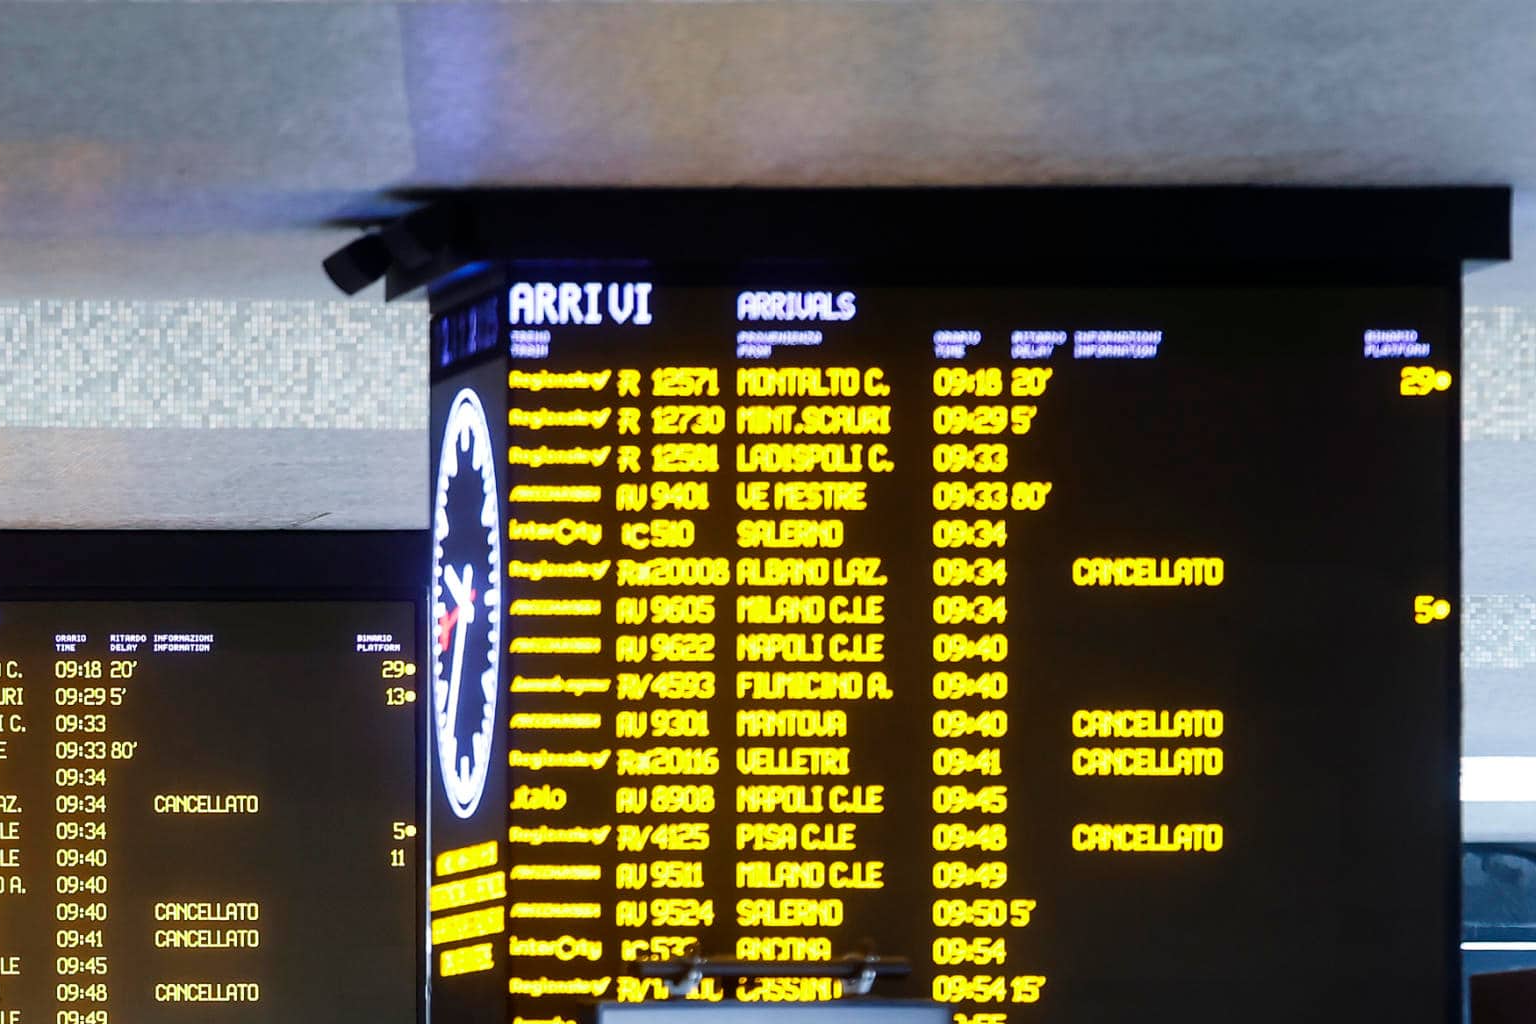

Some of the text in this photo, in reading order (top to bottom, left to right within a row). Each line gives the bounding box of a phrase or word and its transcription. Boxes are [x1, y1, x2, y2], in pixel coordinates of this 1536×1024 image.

[508, 282, 653, 326] ARRIVI
[736, 290, 857, 321] ARRIVALS
[933, 367, 1003, 397] 09:18
[932, 405, 1009, 435] 09:29
[932, 443, 1009, 473] 09:33
[932, 481, 1008, 511] 09:33
[932, 519, 1008, 548] 09:34
[1072, 557, 1224, 586] CANCELLATO
[54, 634, 87, 643] ORARIO
[55, 643, 77, 652] TIME
[109, 633, 148, 643] RITARDO
[109, 642, 138, 652] DELAY
[153, 633, 214, 643] INFORMAZIONI
[153, 643, 211, 652] INFORMATION
[356, 633, 393, 643] BINARIO
[356, 642, 401, 653] PLATFORM
[6, 660, 23, 679] C.
[54, 660, 102, 679] 09:18
[382, 660, 406, 679] 29
[55, 687, 107, 706] 09:29
[385, 687, 406, 706] 13
[9, 714, 26, 733] C.
[55, 714, 106, 733] 09:33
[1072, 709, 1224, 738] CANCELLATO
[55, 741, 107, 760] 09:33
[1072, 747, 1224, 776] CANCELLATO
[55, 768, 107, 787] 09:34
[55, 794, 107, 814] 09:34
[154, 794, 259, 814] CANCELLATO
[55, 821, 107, 840] 09:34
[393, 821, 406, 840] 5
[1071, 823, 1224, 852] CANCELLATO
[56, 848, 107, 867] 09:40
[390, 848, 406, 867] 11
[9, 875, 26, 894] A.
[56, 875, 108, 894] 09:40
[56, 902, 107, 922] 09:40
[154, 902, 259, 921] CANCELLATO
[56, 929, 104, 948] 09:41
[154, 929, 259, 948] CANCELLATO
[56, 956, 108, 975] 09:45
[56, 983, 108, 1002] 09:48
[154, 983, 259, 1002] CANCELLATO
